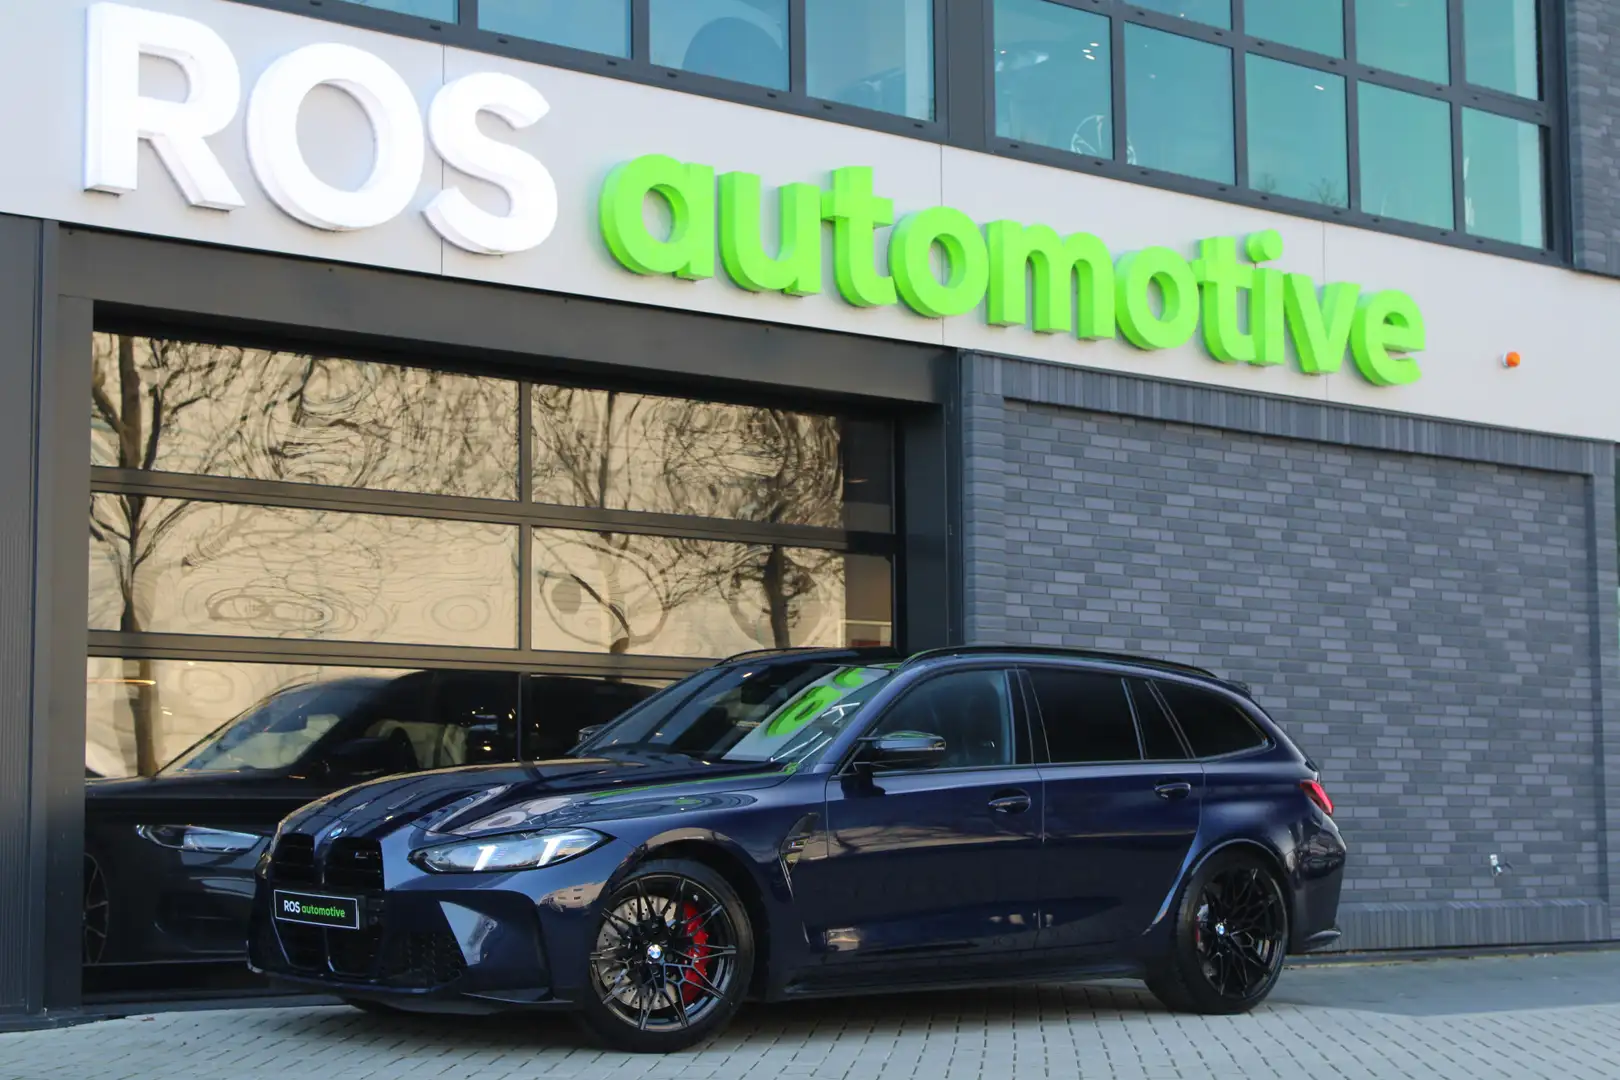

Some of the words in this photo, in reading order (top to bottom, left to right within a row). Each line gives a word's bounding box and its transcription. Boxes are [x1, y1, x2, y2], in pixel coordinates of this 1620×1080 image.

[84, 2, 558, 254] ROS
[600, 155, 1426, 386] automotive
[284, 900, 301, 913] ROS
[302, 905, 345, 918] automotive
